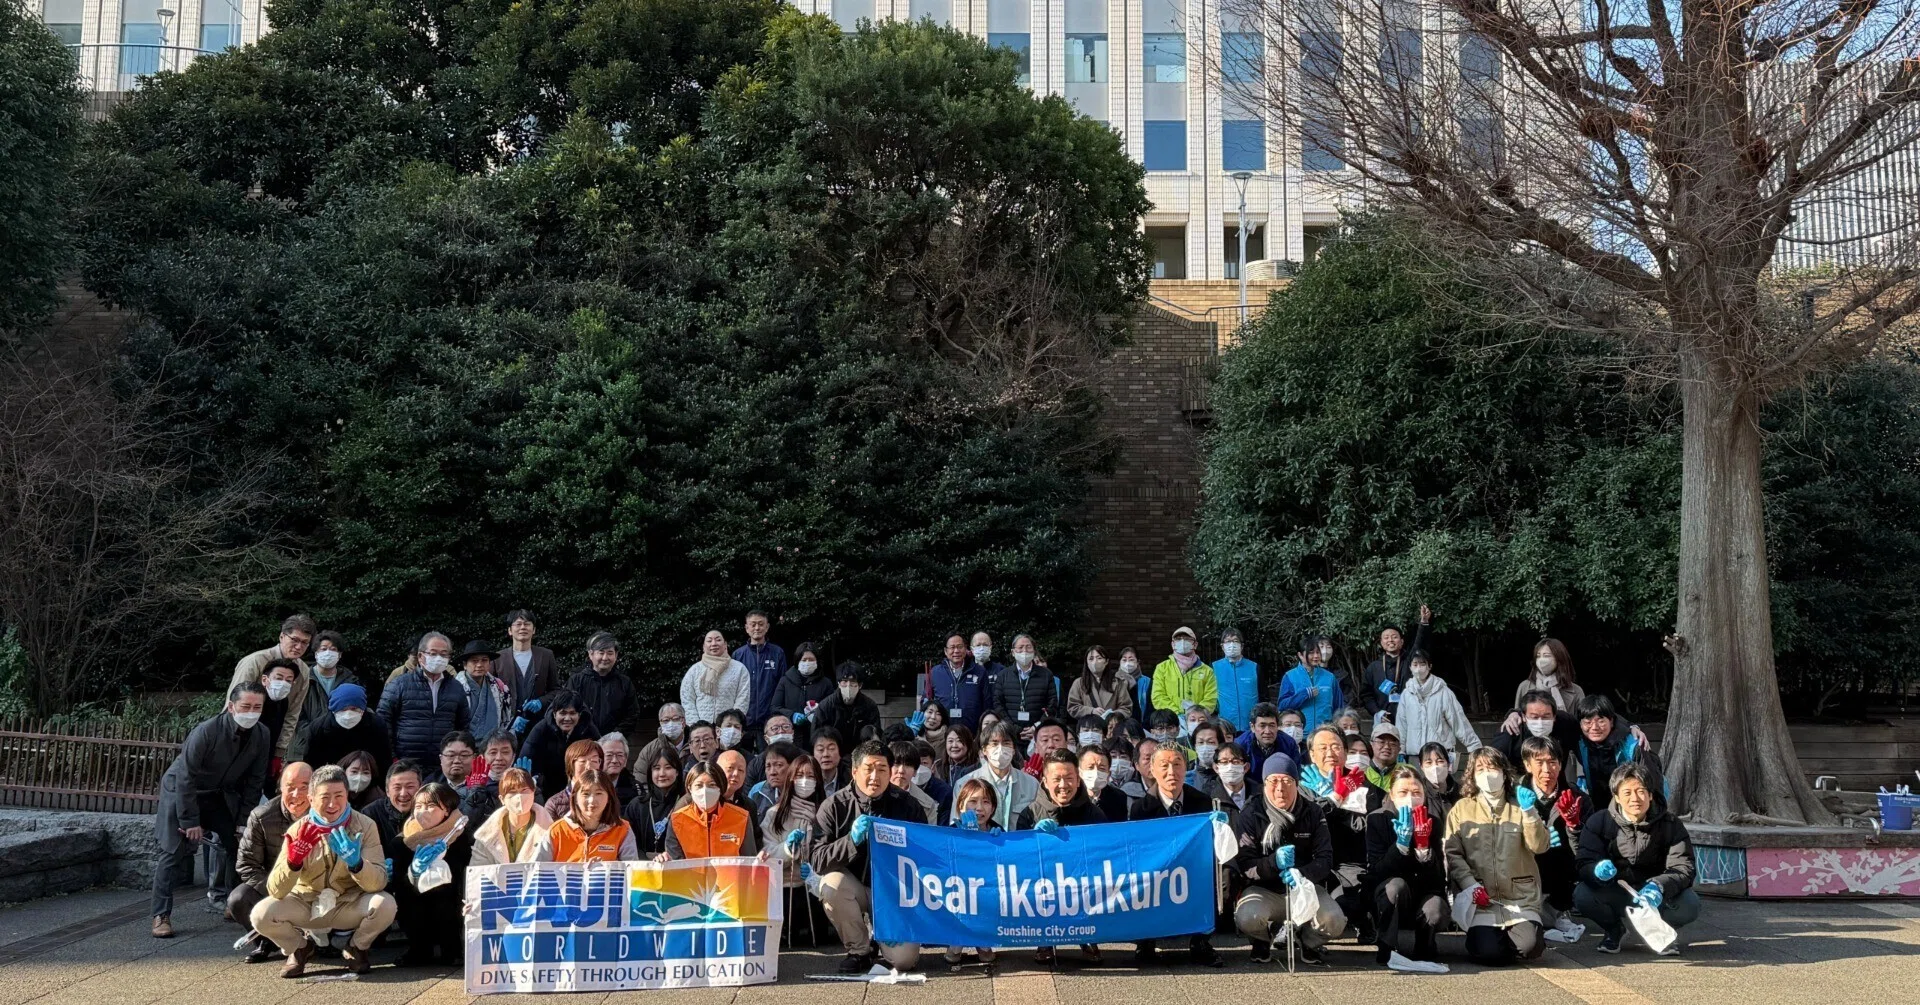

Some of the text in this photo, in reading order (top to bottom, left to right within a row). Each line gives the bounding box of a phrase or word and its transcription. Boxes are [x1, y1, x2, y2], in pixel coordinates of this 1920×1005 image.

[480, 869, 625, 931] NAUI
[897, 854, 1189, 918] Dear Ikebukuro
[488, 929, 757, 962] WORLDWIDE
[997, 925, 1096, 937] Sunshine City Group
[480, 961, 766, 985] DIVE SAFETY THROUGH EDUCATION
